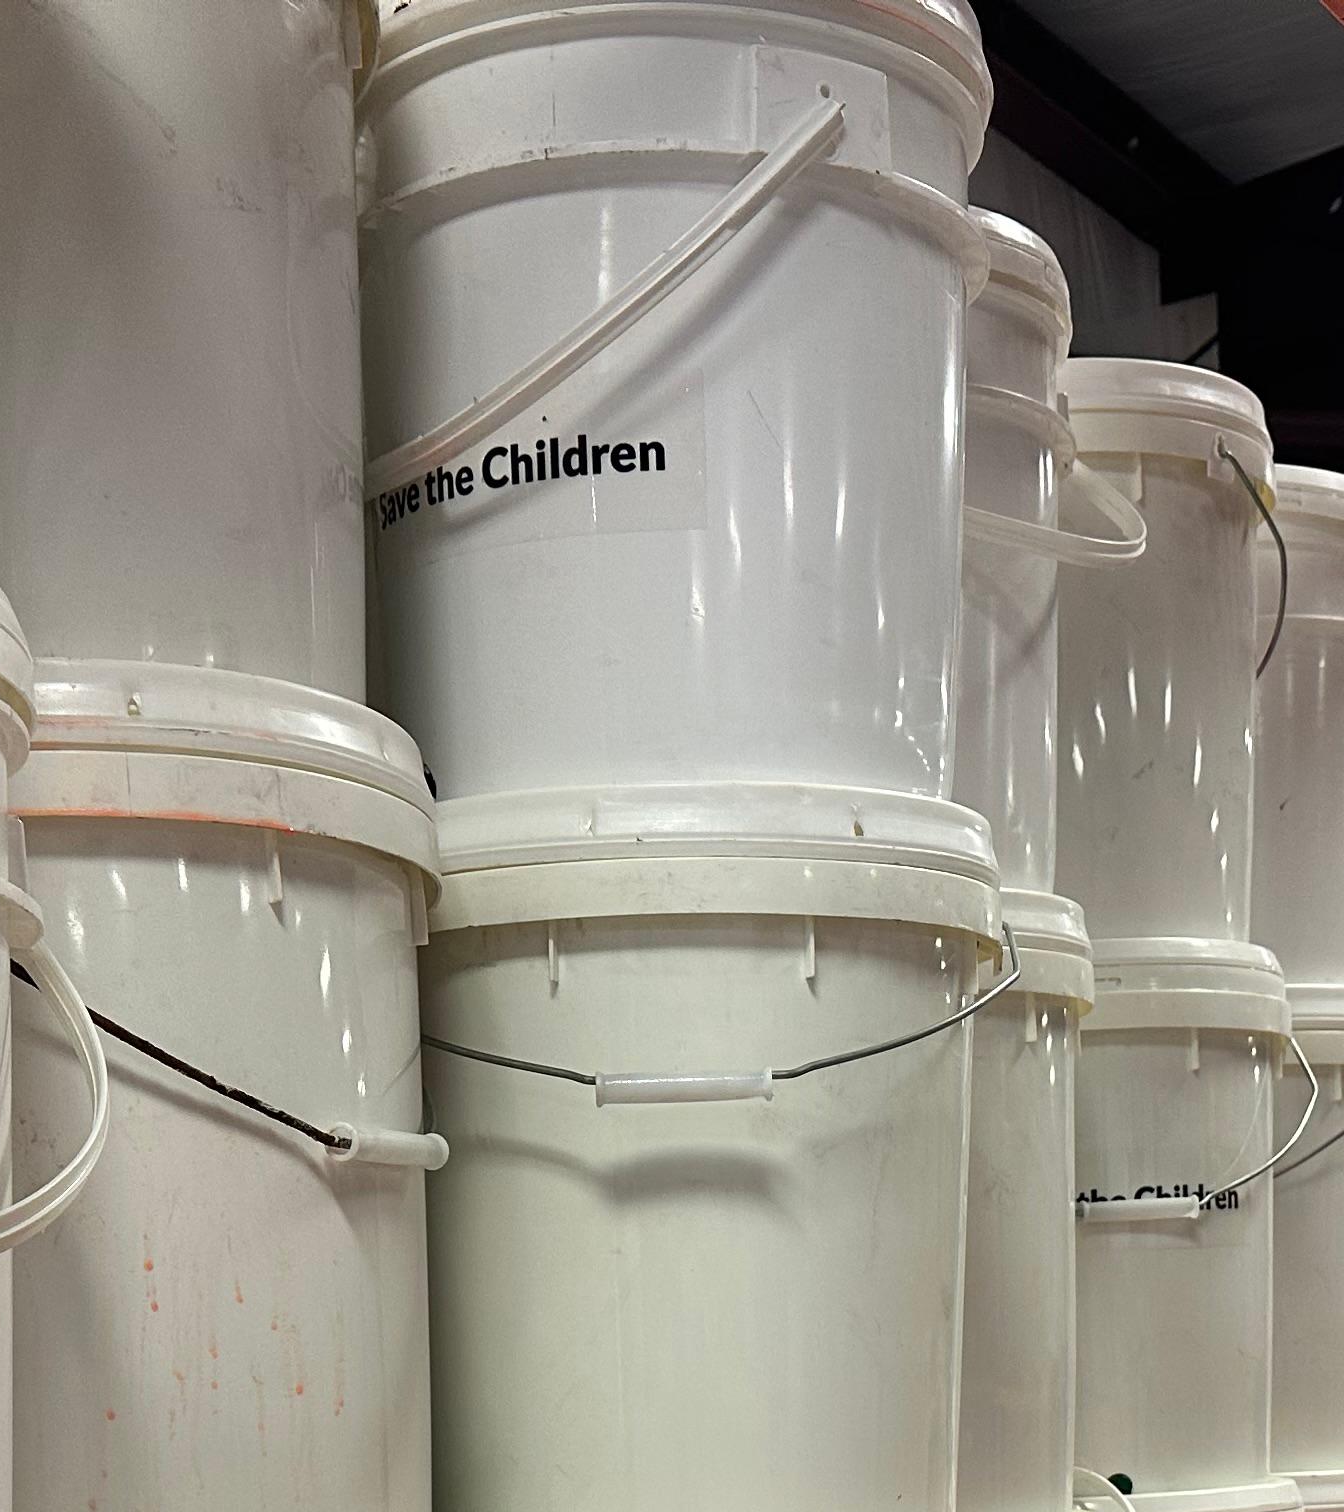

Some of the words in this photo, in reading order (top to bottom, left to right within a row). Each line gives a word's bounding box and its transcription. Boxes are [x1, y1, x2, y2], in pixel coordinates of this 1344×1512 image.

[378, 480, 420, 530] Save
[424, 465, 474, 506] the
[482, 434, 666, 489] Children
